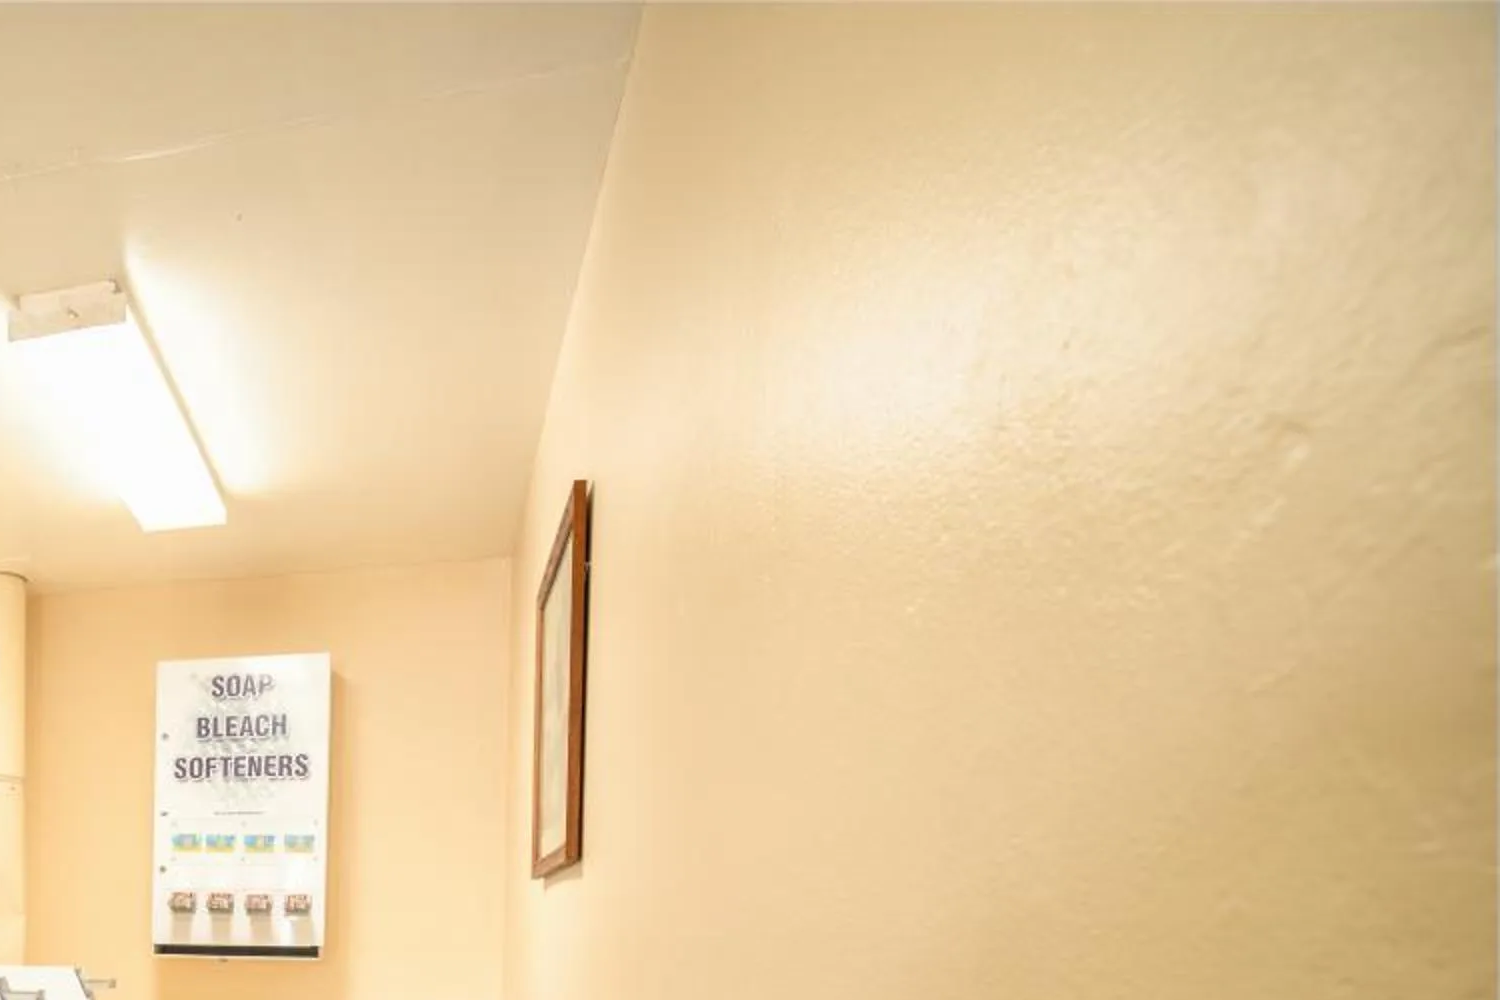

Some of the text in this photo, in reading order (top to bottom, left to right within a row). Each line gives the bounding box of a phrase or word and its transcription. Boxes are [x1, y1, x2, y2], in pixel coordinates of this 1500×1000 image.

[212, 675, 274, 698] SOAP
[197, 714, 287, 739] BLEACH
[174, 754, 309, 779] SOFTENERS
